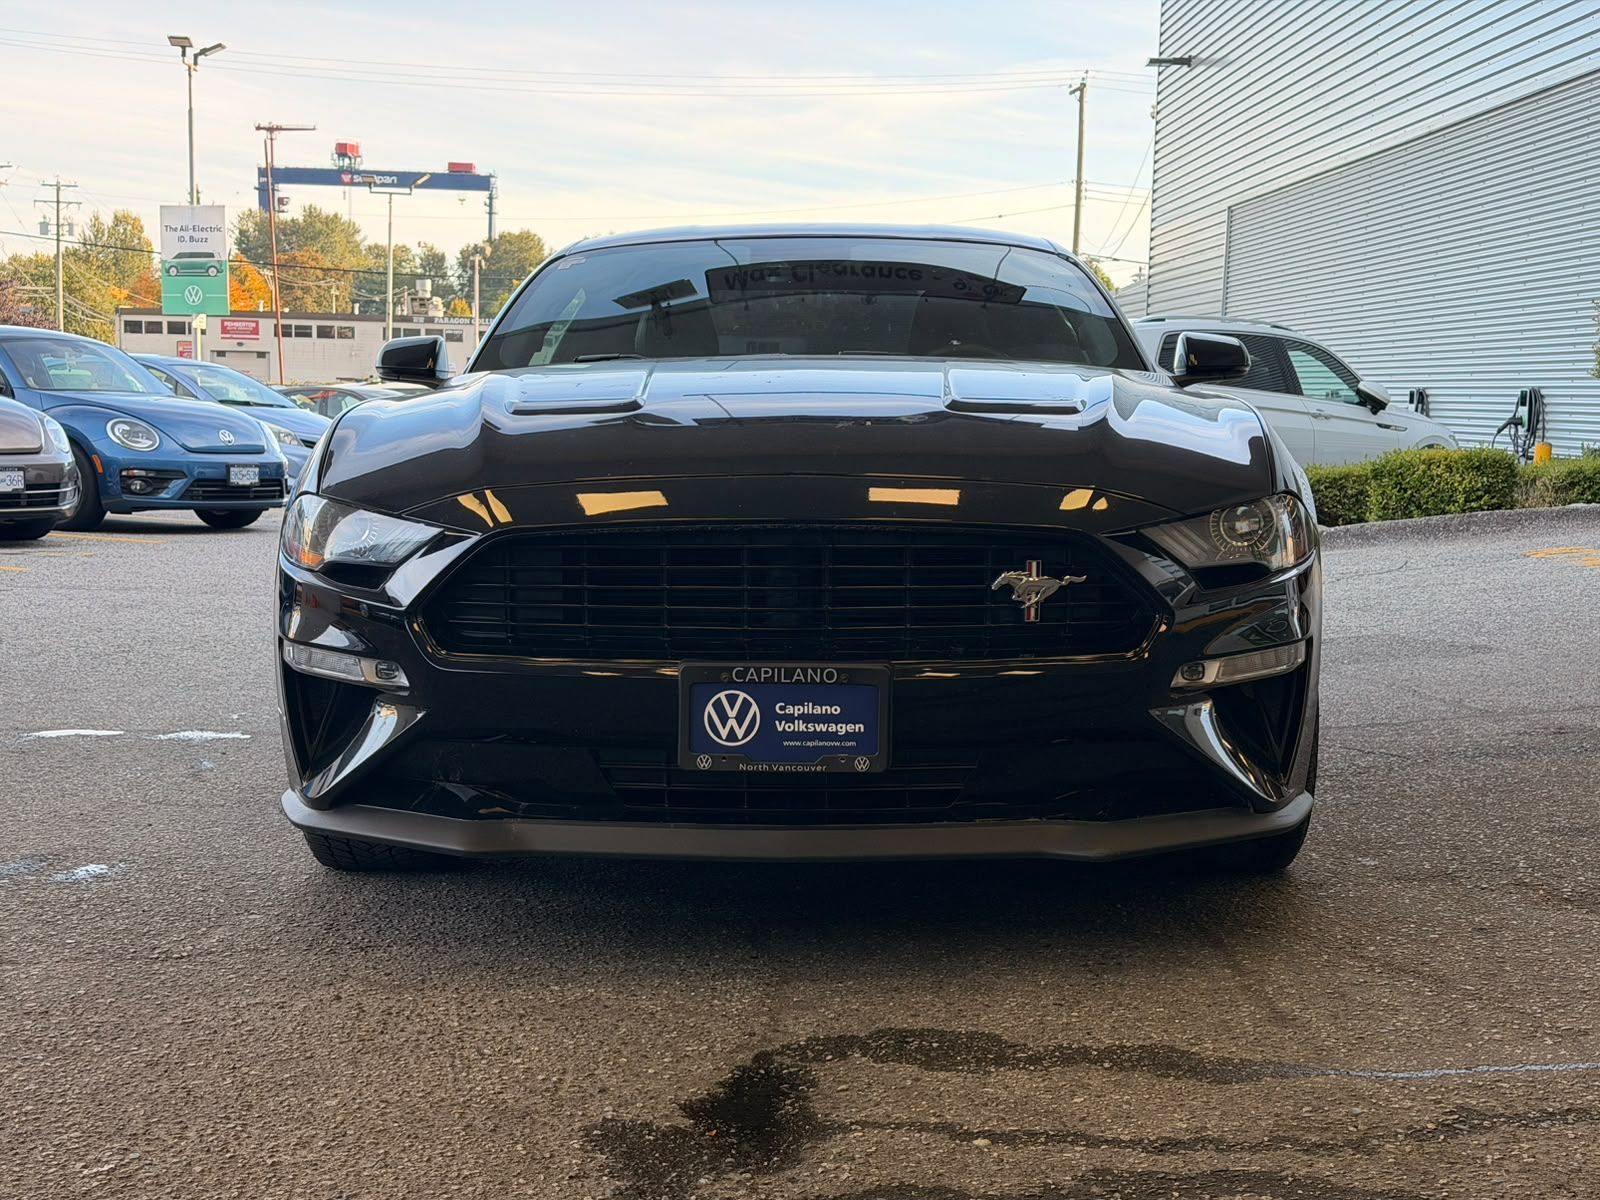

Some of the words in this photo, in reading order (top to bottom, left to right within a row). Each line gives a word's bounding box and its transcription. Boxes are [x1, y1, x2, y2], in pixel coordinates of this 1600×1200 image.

[164, 225, 178, 233] The
[180, 225, 223, 233] All-Electric
[189, 235, 209, 243] Buzz
[731, 667, 838, 683] CAPILANO
[775, 702, 841, 717] Capilano
[775, 720, 865, 735] Volkswagen
[783, 739, 857, 748] www.capilanovw.com
[739, 763, 769, 772] North
[771, 764, 827, 772] Vancouver
